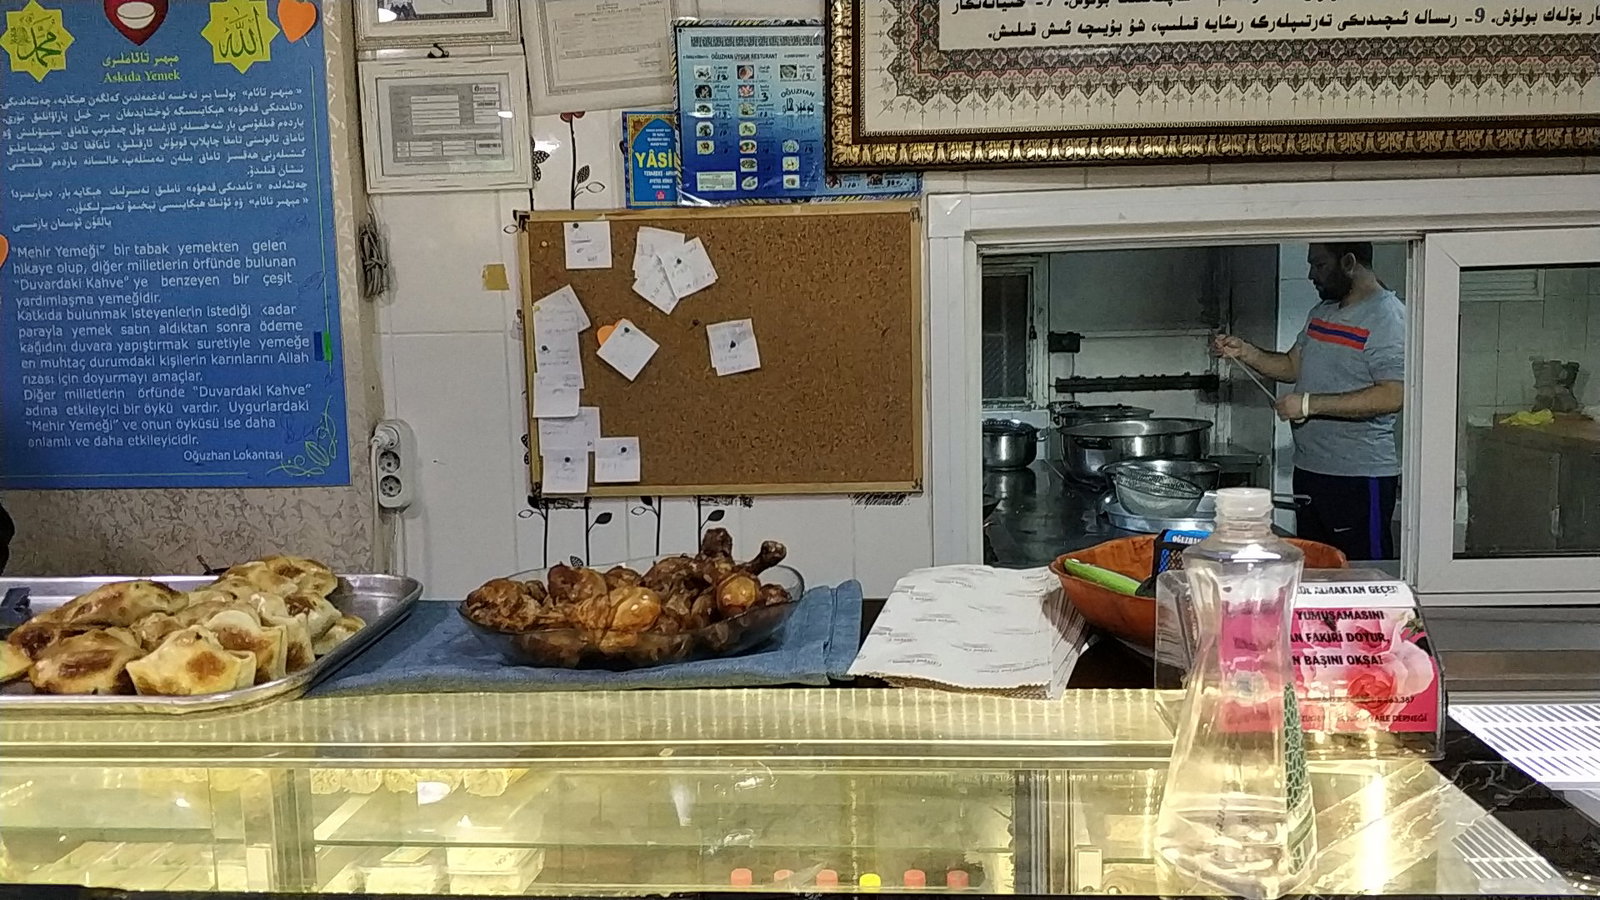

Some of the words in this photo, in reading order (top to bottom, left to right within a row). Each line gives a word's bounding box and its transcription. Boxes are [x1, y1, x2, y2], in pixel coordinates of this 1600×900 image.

[145, 69, 181, 82] Yemek
[113, 244, 130, 256] bir
[134, 243, 170, 256] tabak
[177, 241, 239, 255] yemekten
[252, 240, 287, 254] gelen
[13, 263, 53, 276] hikaye
[57, 262, 88, 275] olup,
[91, 260, 123, 275] diğer
[127, 258, 189, 271] milletlerin
[192, 257, 241, 269] örfünde
[245, 256, 297, 269] bulunan
[133, 277, 149, 290] ye
[161, 274, 220, 288] benzeyen
[233, 273, 249, 285] bir
[262, 272, 293, 286] çeşit
[16, 294, 94, 309] yardımlaşma
[98, 292, 161, 307] yemeğidir.
[17, 309, 62, 322] Katkıda
[66, 308, 127, 321] bulunmak
[131, 306, 202, 320] isteyenlerin
[206, 304, 251, 318] istediği
[18, 325, 63, 339] parayla
[71, 324, 113, 338] yemek
[121, 322, 150, 336] satın
[159, 322, 208, 334] aldıktan
[216, 323, 251, 333] sonra
[259, 320, 303, 332] ödeme
[71, 340, 112, 352] duvara
[117, 338, 189, 353] yapıştırmak
[197, 337, 251, 352] suretiyle
[259, 335, 310, 350] yemeğe
[21, 360, 36, 369] en
[40, 357, 86, 370] muhtaç
[89, 355, 155, 367] durumdaki
[159, 354, 207, 368] kişilerin
[211, 354, 273, 365] karınlarını
[277, 352, 309, 364] Allah
[58, 372, 78, 386] için
[82, 372, 147, 385] doyurmayı
[152, 370, 203, 384] amaçlar.
[23, 389, 56, 403] Diğer
[64, 388, 125, 400] milletlerin
[137, 386, 185, 398] örfünde
[25, 405, 58, 416] adına
[66, 404, 119, 417] etkileyici
[123, 404, 140, 415] bir
[144, 402, 173, 417] öykü
[182, 402, 220, 413] vardır.
[228, 400, 309, 414] Uygurlardaki
[122, 421, 138, 430] ve
[141, 420, 172, 430] onun
[176, 418, 219, 431] öyküsü
[224, 417, 241, 429] ise
[245, 416, 276, 429] daha
[75, 437, 90, 447] ve
[93, 435, 124, 447] daha
[127, 434, 199, 448] etkileyicidir.
[183, 450, 231, 463] Oğuzhan
[233, 449, 284, 461] Lokantası
[1305, 631, 1343, 643] FAKİRİ
[1345, 632, 1390, 644] DOYUR,
[1304, 655, 1344, 668] BAŞINI
